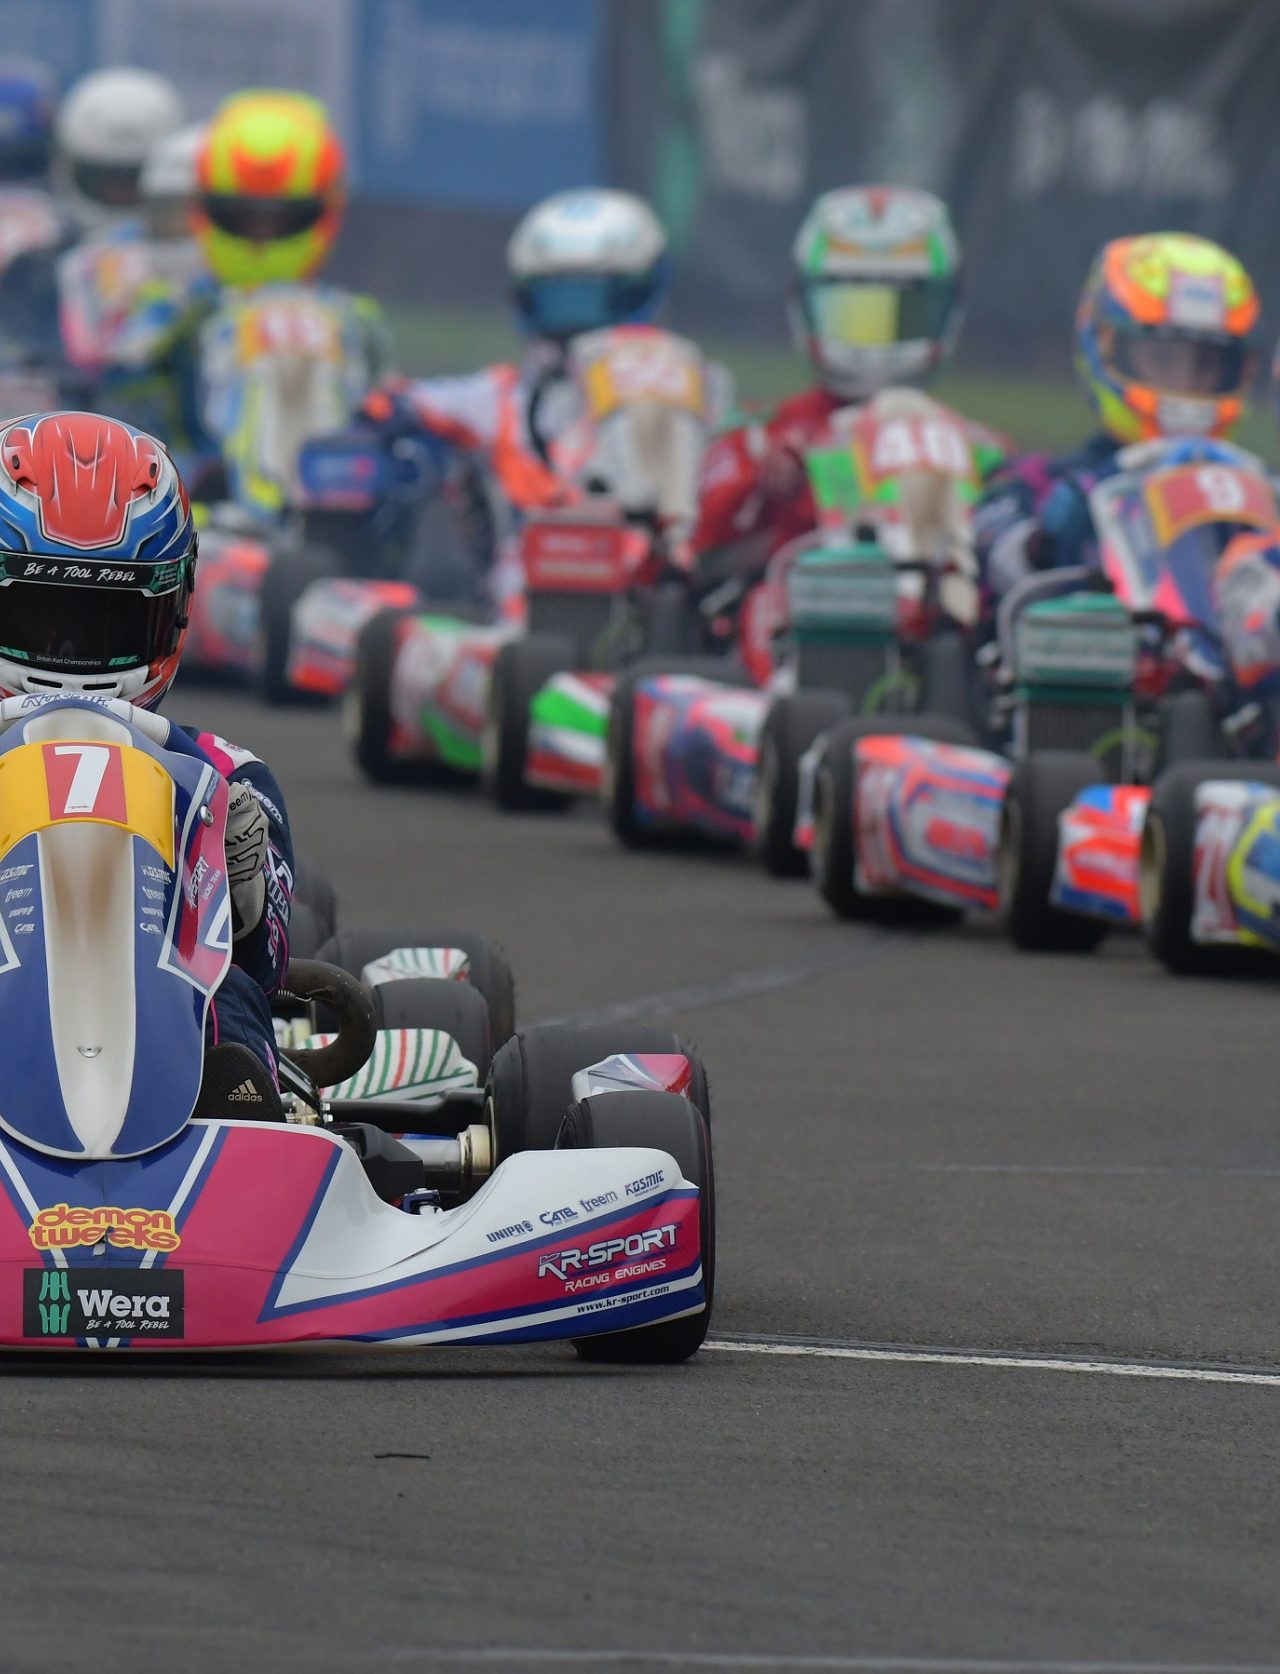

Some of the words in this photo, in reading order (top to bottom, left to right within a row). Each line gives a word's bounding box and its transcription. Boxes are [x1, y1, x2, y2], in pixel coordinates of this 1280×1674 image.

[23, 562, 45, 576] BE
[47, 565, 59, 575] A
[63, 565, 93, 578] TOOL
[96, 568, 137, 581] REBEL
[54, 745, 110, 814] 7
[228, 1092, 263, 1102] adidas
[624, 1169, 665, 1196] KOSMIC
[580, 1190, 618, 1214] freem
[37, 1206, 172, 1230] demon
[486, 1219, 534, 1244] UNIPRO
[538, 1223, 680, 1281] KR-SPORT
[564, 1272, 610, 1292] RACING
[614, 1258, 667, 1280] ENGINES
[76, 1289, 171, 1318] Wera
[577, 1284, 670, 1314] www.kr-sport.com
[86, 1319, 101, 1330] BE
[103, 1320, 113, 1328] A
[115, 1319, 136, 1330] TOOL
[139, 1319, 170, 1330] REBEL
